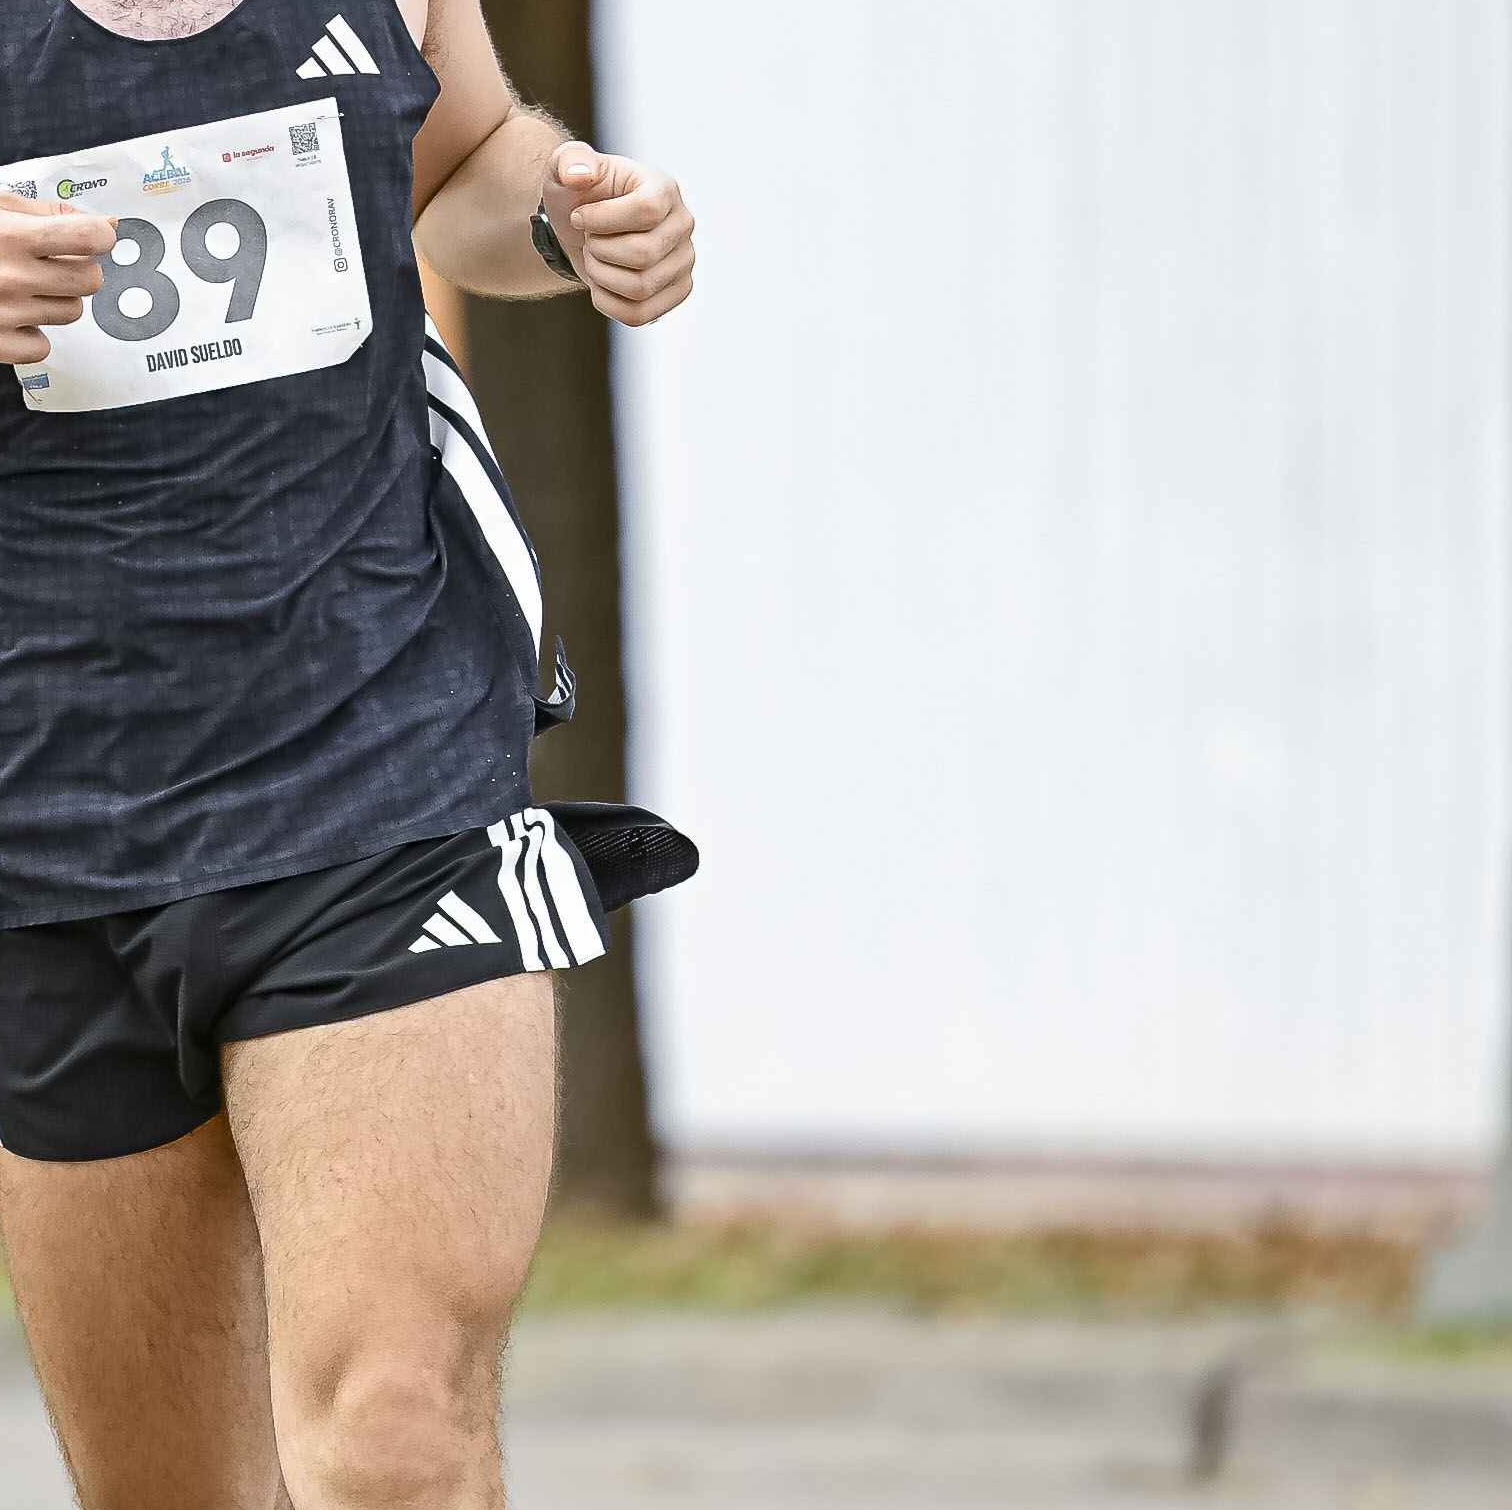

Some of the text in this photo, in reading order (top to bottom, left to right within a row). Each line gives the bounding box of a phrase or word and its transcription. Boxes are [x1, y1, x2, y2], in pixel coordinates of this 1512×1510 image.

[143, 166, 190, 184] ACEBAL
[327, 197, 343, 256] @CRONORAV
[92, 199, 267, 341] 89
[146, 338, 243, 372] DAVID SUELDO
